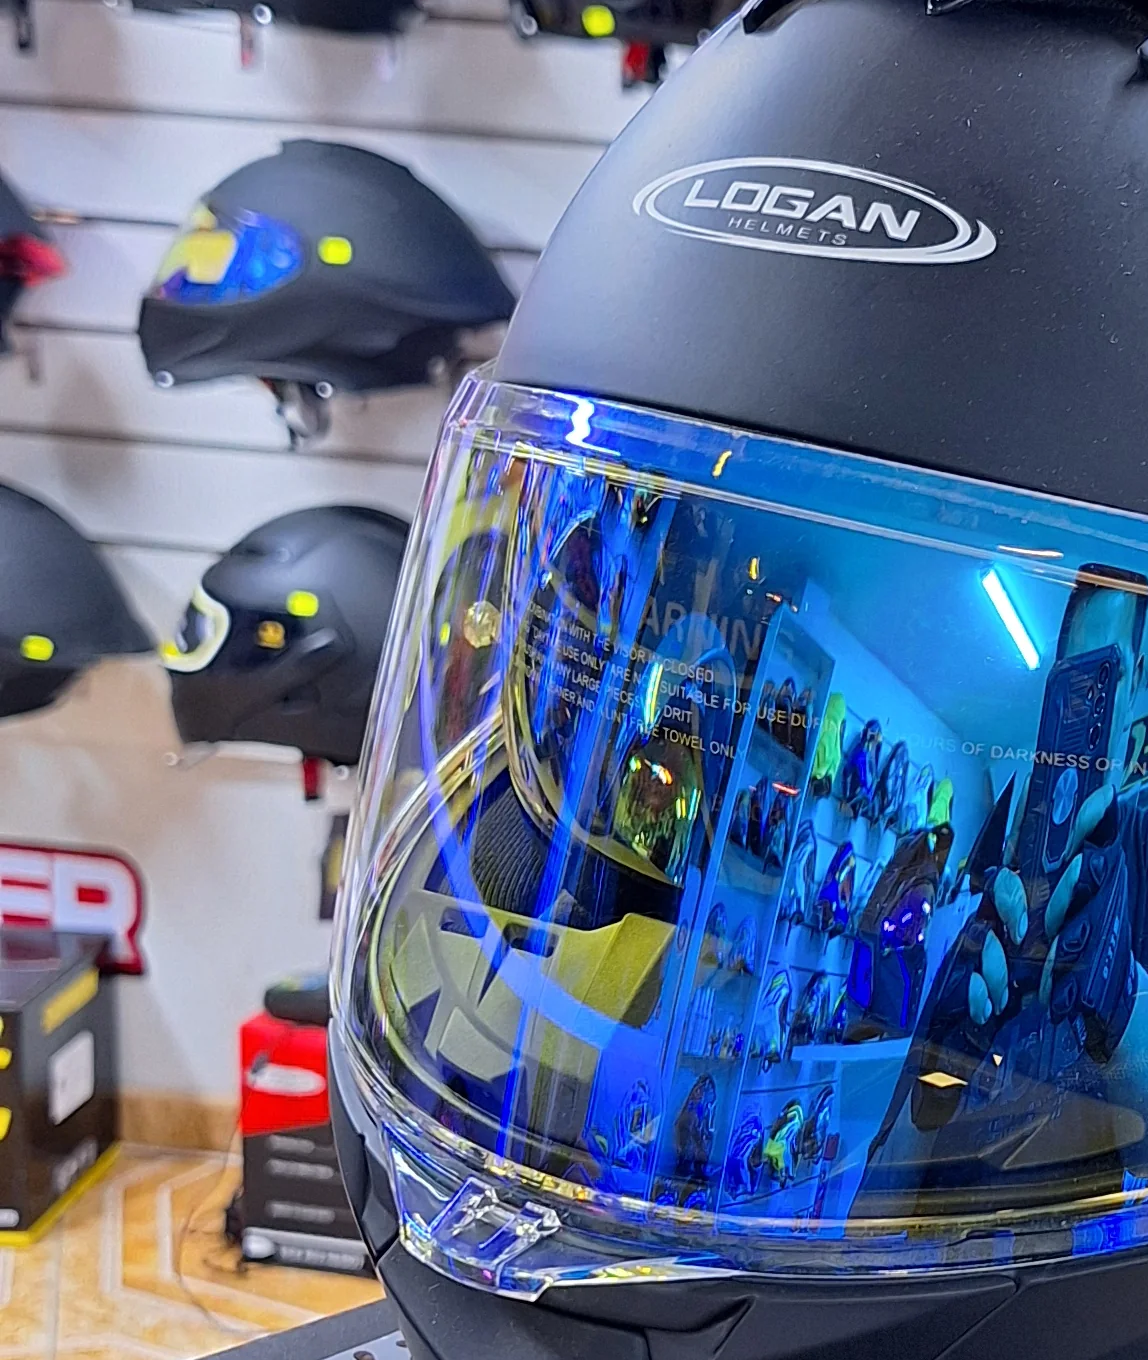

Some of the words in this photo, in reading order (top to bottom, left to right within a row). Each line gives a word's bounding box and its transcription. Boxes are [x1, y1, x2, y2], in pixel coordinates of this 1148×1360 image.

[684, 179, 920, 242] LOGAN
[727, 215, 848, 246] HELMETS
[663, 658, 714, 683] CLOSED
[581, 652, 605, 671] ONLY
[660, 681, 720, 710] SUITABLE
[723, 699, 752, 715] FOR
[757, 707, 788, 725] USE
[961, 742, 986, 756] OF
[990, 745, 1091, 772] DARKNESS
[1095, 757, 1123, 772] OR
[1128, 761, 1148, 776] IN
[663, 705, 694, 725] DRIT
[663, 727, 706, 752] TOWEL
